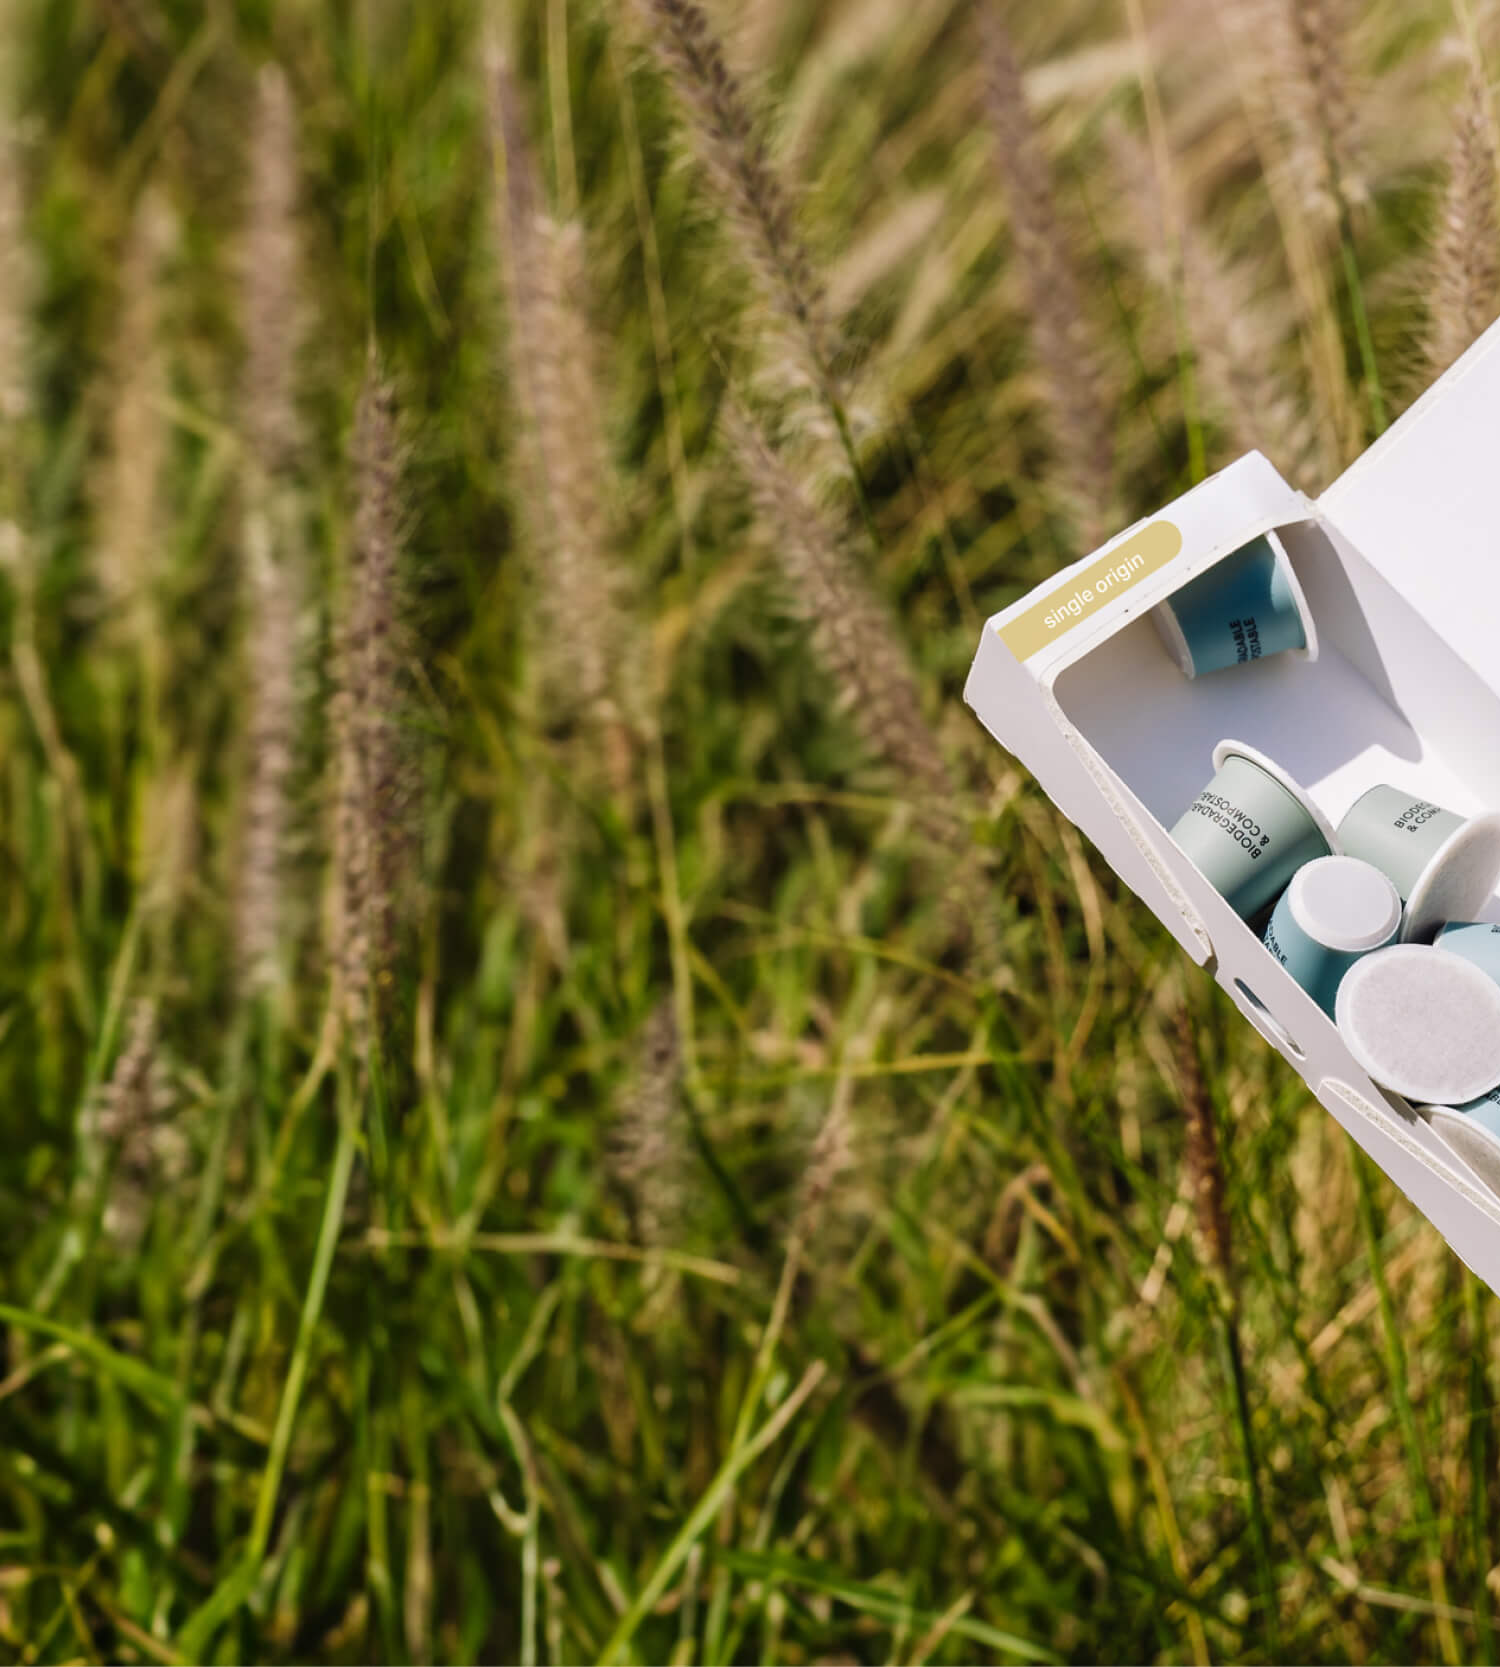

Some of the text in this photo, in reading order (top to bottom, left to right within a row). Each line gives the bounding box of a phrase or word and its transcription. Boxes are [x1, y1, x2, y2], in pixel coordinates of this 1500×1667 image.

[1043, 552, 1145, 629] single origin
[1259, 834, 1270, 847] &
